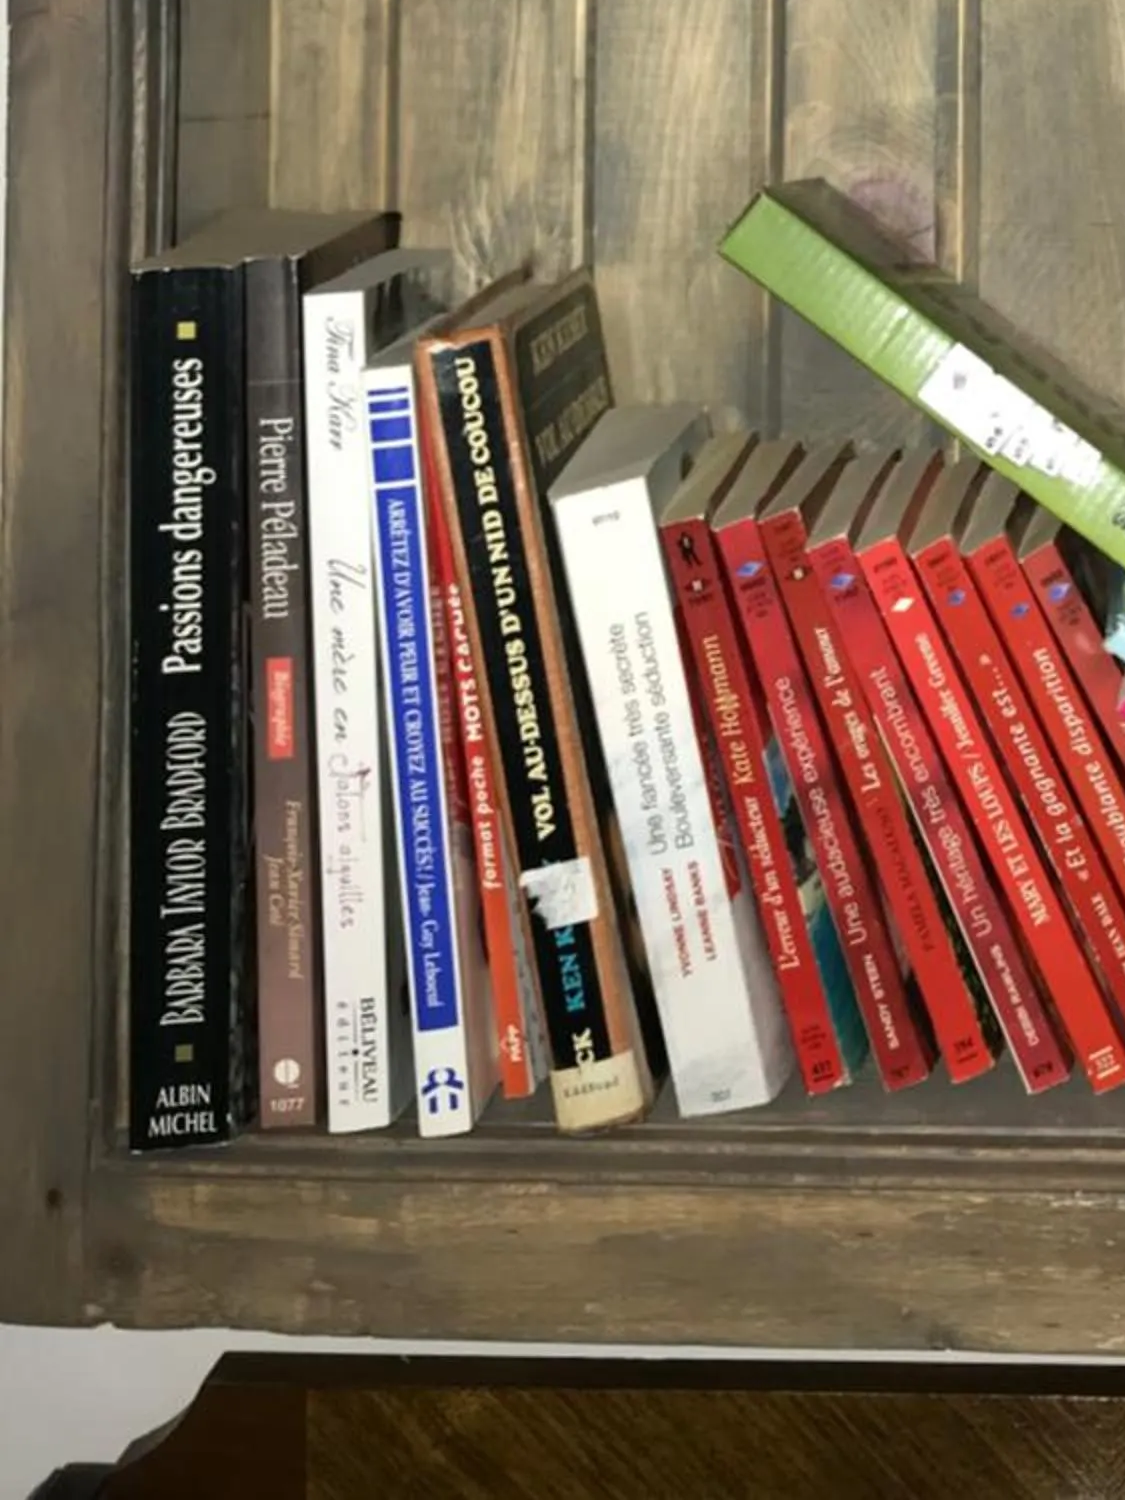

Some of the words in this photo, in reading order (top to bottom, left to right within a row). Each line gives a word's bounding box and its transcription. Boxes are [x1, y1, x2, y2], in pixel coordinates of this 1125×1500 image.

[324, 314, 357, 373] Tina
[325, 379, 361, 451] Karr
[452, 357, 491, 466] COUCOU
[158, 358, 215, 540] dangereuses
[257, 416, 296, 493] Pierre
[472, 465, 497, 505] DE
[259, 499, 300, 618] Péladeau
[387, 496, 413, 568] ARRÊTEZ
[480, 510, 508, 563] NID
[158, 549, 202, 675] Passions
[326, 557, 367, 615] Une
[393, 570, 417, 637] D'AVOIR
[489, 565, 521, 634] D'UN
[329, 625, 355, 693] mère
[397, 640, 418, 682] PEUR
[604, 622, 636, 696] secrète
[630, 610, 665, 708] séduction
[699, 632, 747, 738] Hoffmann
[270, 669, 292, 745] Biographie
[332, 706, 348, 743] en
[401, 685, 420, 704] ET
[457, 678, 484, 743] MOTS
[503, 638, 547, 784] AU-DESSUS
[620, 698, 645, 738] très
[829, 687, 853, 710] de
[867, 664, 931, 785] encombrant
[1027, 644, 1096, 760] disparition
[403, 707, 426, 772] CROYEZ
[768, 675, 820, 785] expérience
[159, 711, 205, 830] BRADFORD
[408, 777, 428, 801] AU
[465, 754, 493, 816] poche
[628, 740, 659, 811] fiancée
[649, 709, 695, 850] Bouleversante
[727, 738, 755, 786] Kate
[854, 761, 882, 794] Les
[965, 760, 1004, 820] LOUPS
[1008, 719, 1067, 819] gagnante
[530, 785, 557, 840] VOL
[643, 815, 668, 856] Une
[738, 794, 775, 869] séducteur
[918, 784, 947, 825] très
[990, 818, 1019, 853] LES
[1051, 821, 1075, 845] la
[473, 819, 502, 891] format
[803, 787, 854, 900] audacieuse
[934, 822, 982, 904] héritage
[1004, 852, 1029, 878] ET
[159, 839, 205, 919] TAYLOR
[660, 866, 682, 922] LINDSAY
[686, 860, 705, 907] BANKS
[1016, 876, 1051, 926] MARY
[672, 923, 693, 979] YVONNE
[695, 908, 717, 962] LEANNE
[837, 900, 869, 946] Une
[966, 904, 993, 938] Un
[159, 922, 204, 1026] BARBARA
[558, 953, 586, 1012] KEN
[359, 996, 380, 1102] BÉLIVEAU
[875, 1001, 901, 1050] SANDY
[148, 1110, 217, 1138] MICHEL
[156, 1083, 211, 1109] ALBIN
[270, 1098, 304, 1113] 1077
